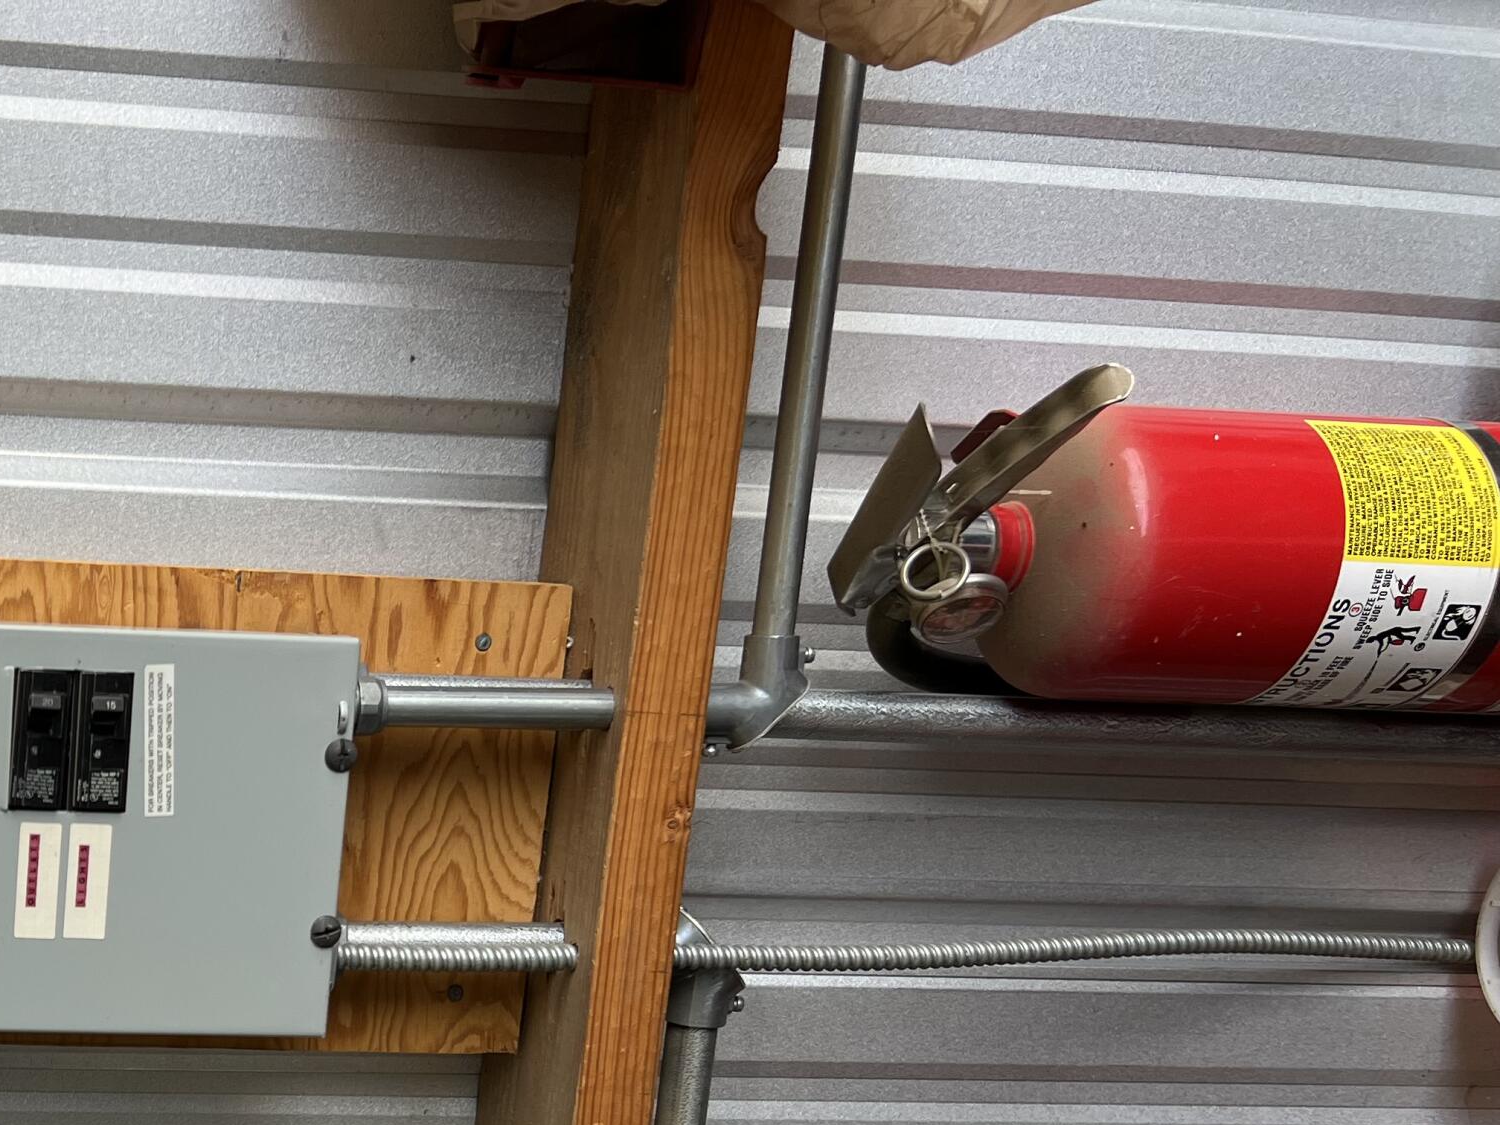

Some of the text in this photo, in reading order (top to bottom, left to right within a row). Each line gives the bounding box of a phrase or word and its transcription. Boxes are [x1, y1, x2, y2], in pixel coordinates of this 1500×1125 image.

[1362, 480, 1371, 503] GAUGE
[1350, 480, 1360, 515] INTERVALS
[1460, 491, 1468, 527] STANDARD
[1402, 537, 1408, 546] TO
[1439, 537, 1444, 546] BE
[1401, 549, 1406, 558] ER
[1419, 548, 1424, 558] TO
[1437, 549, 1443, 560] TO
[1485, 552, 1491, 561] TO
[1354, 569, 1384, 631] SQUEEZE LEVER
[1353, 569, 1394, 649] SWEEP SIDE TO SIDE
[1325, 656, 1343, 670] FEET
[106, 700, 116, 710] 15
[157, 703, 163, 713] BY
[166, 702, 172, 712] TO
[166, 773, 172, 782] TO
[27, 835, 39, 906] OUTLETS
[76, 846, 88, 905] LIGHTS
